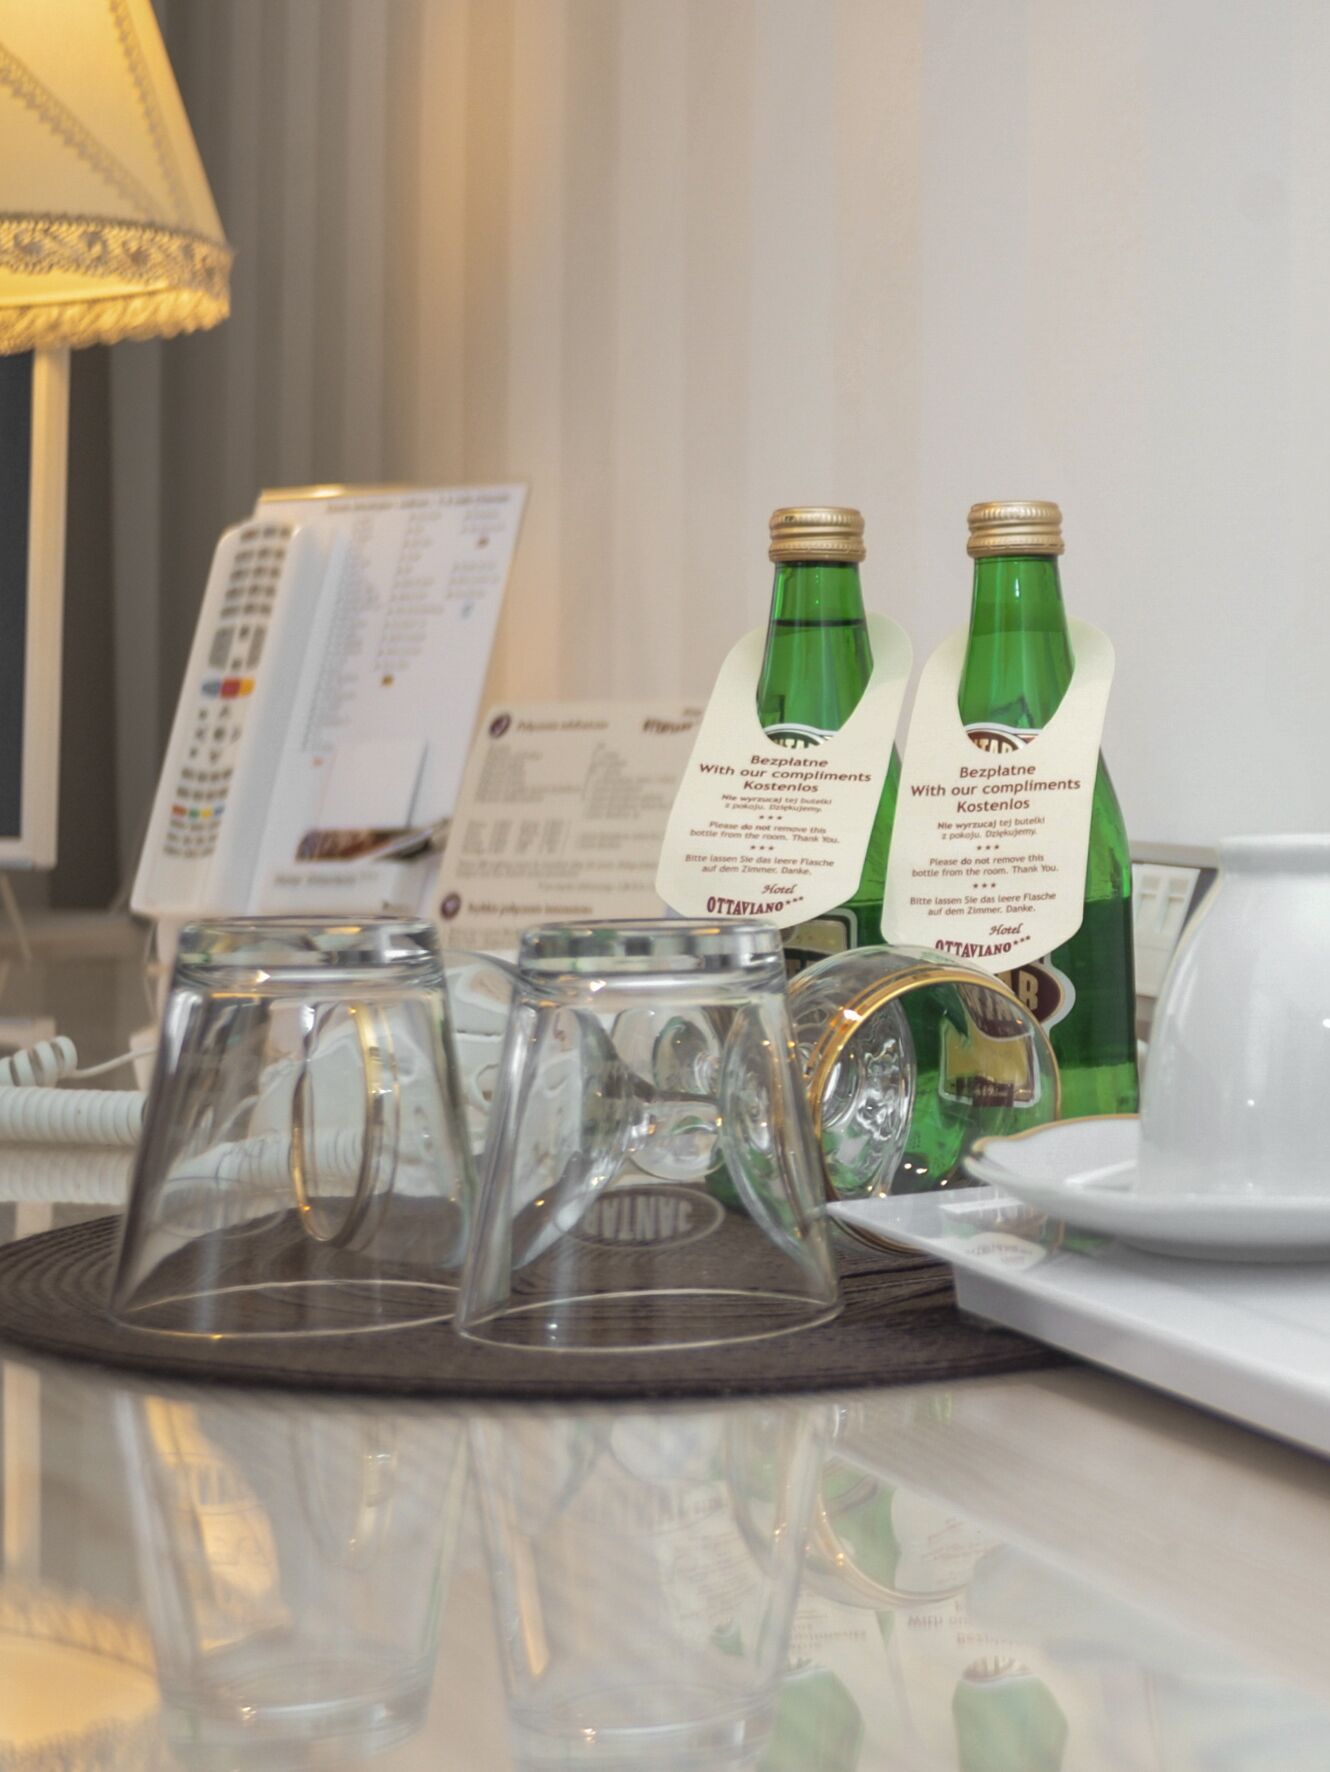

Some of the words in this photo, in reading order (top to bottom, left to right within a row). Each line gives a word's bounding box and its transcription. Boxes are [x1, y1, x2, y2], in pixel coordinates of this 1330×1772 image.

[750, 755, 829, 768] Bezpłatne
[699, 763, 735, 776] With
[740, 769, 766, 778] our
[771, 769, 872, 783] compliments
[959, 765, 1036, 780] Bezpłatne
[743, 781, 819, 793] Kostenlos
[911, 784, 946, 797] With
[951, 785, 977, 796] our
[982, 778, 1081, 796] compliments
[957, 798, 1030, 813] Kostenlos
[709, 821, 738, 830] Please
[741, 823, 752, 831] do
[810, 826, 827, 834] this
[937, 822, 952, 830] Nie
[955, 820, 996, 832] wyrzucaj
[999, 818, 1012, 828] tej
[1014, 816, 1045, 826] butelki
[689, 829, 718, 838] bottle
[721, 830, 742, 839] from
[744, 831, 760, 840] the
[762, 833, 787, 841] room.
[792, 833, 819, 843] Thank
[822, 835, 841, 844] You.
[949, 830, 981, 841] pokoju.
[685, 854, 707, 863] Bitte
[710, 855, 738, 863] lassen
[739, 855, 754, 864] Sie
[756, 856, 771, 865] das
[774, 857, 798, 865] leere
[800, 858, 835, 867] Flasche
[930, 857, 957, 866] Please
[960, 856, 972, 865] do
[993, 855, 1026, 864] remove
[1028, 853, 1045, 862] this
[702, 864, 717, 873] auf
[719, 864, 739, 873] dem
[741, 865, 778, 874] Zimmer.
[781, 866, 812, 875] Danke.
[912, 868, 939, 877] bottle
[941, 868, 963, 876] from
[966, 867, 981, 876] the
[983, 868, 1008, 876] room.
[1012, 865, 1038, 874] Thank
[1041, 864, 1059, 872] You.
[761, 884, 797, 895] Hotel
[910, 896, 932, 905] Bitte
[934, 896, 962, 905] lassen
[964, 895, 978, 904] Sie
[980, 895, 995, 903] das
[998, 894, 1021, 903] leere
[1023, 892, 1056, 901] Flasche
[927, 907, 942, 916] auf
[945, 906, 965, 915] dem
[967, 906, 1002, 915] Zimmer.
[1006, 904, 1036, 913] Danke.
[989, 923, 1024, 936] Hotel
